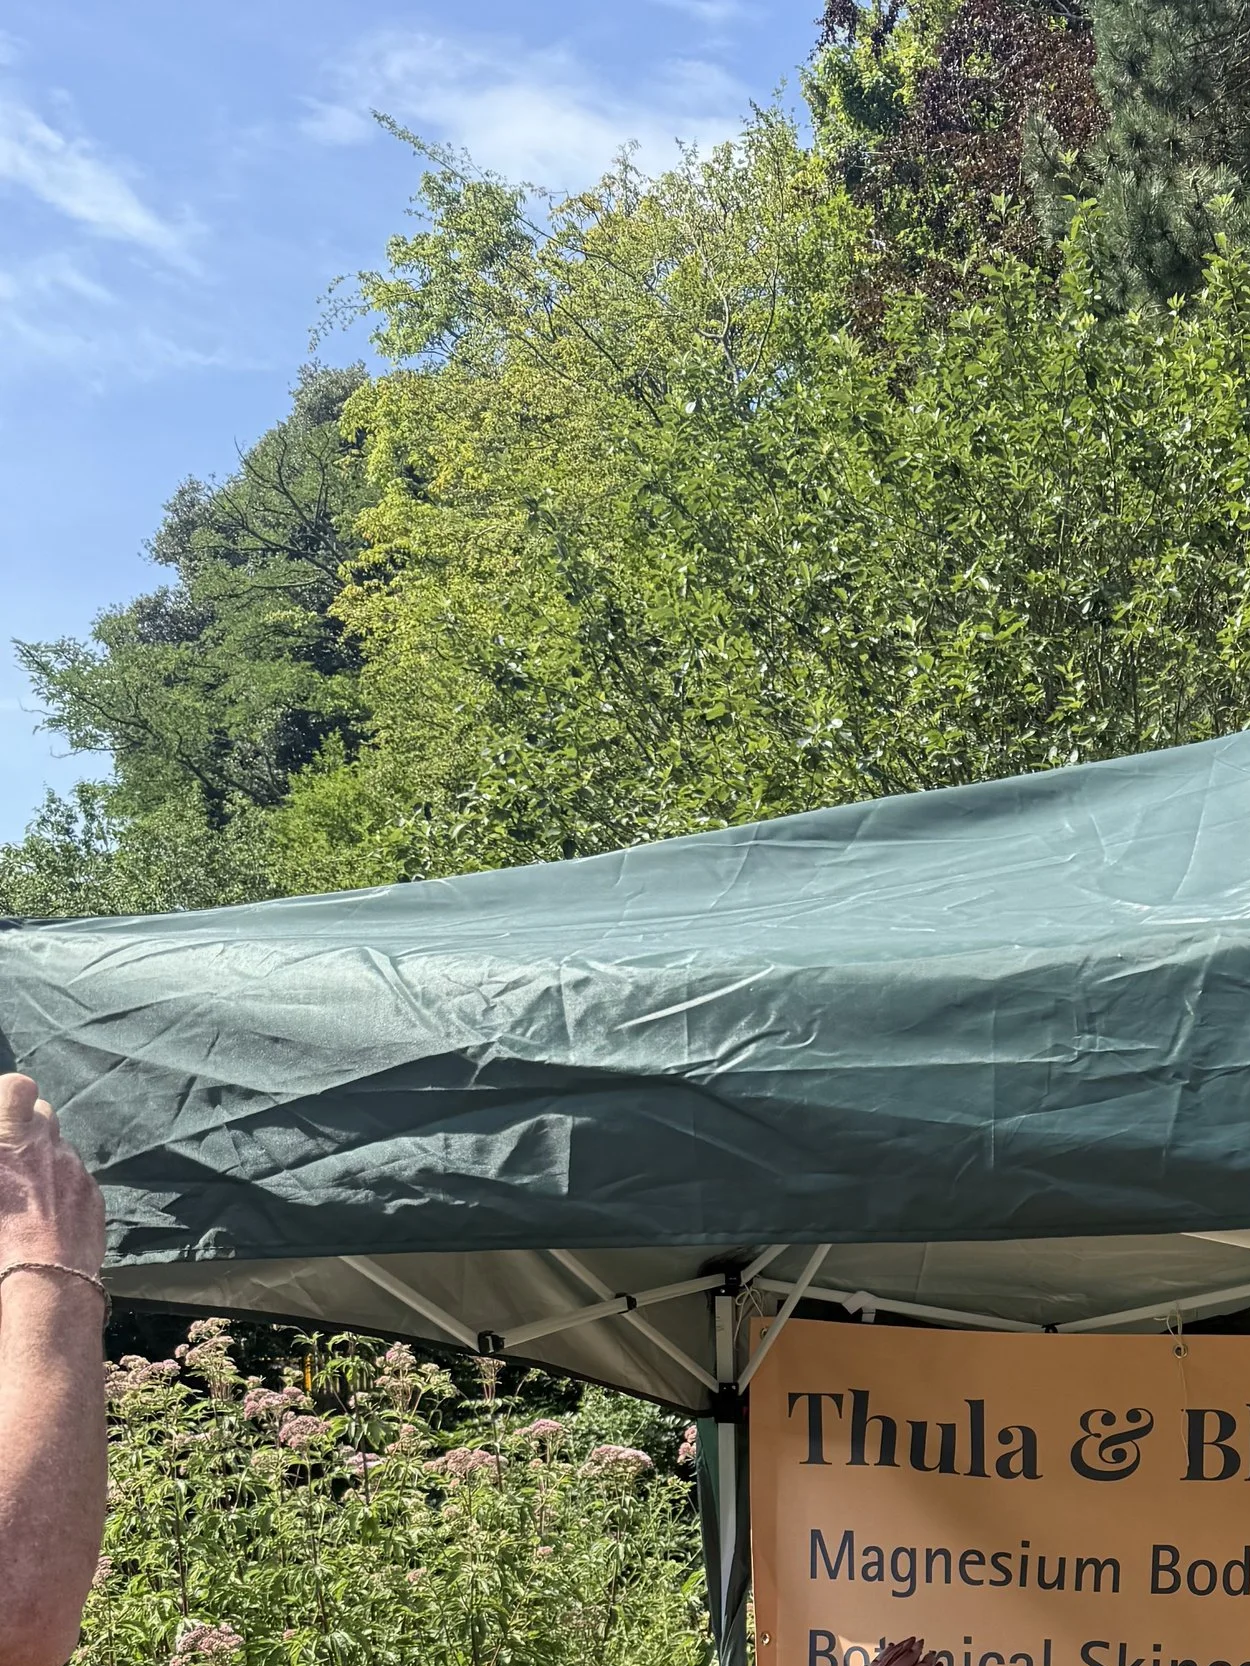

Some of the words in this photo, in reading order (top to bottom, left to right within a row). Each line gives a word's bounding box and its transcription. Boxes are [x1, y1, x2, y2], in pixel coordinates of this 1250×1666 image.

[788, 1389, 1043, 1480] Thula
[1070, 1407, 1154, 1481] &
[809, 1529, 1121, 1598] Magnesium
